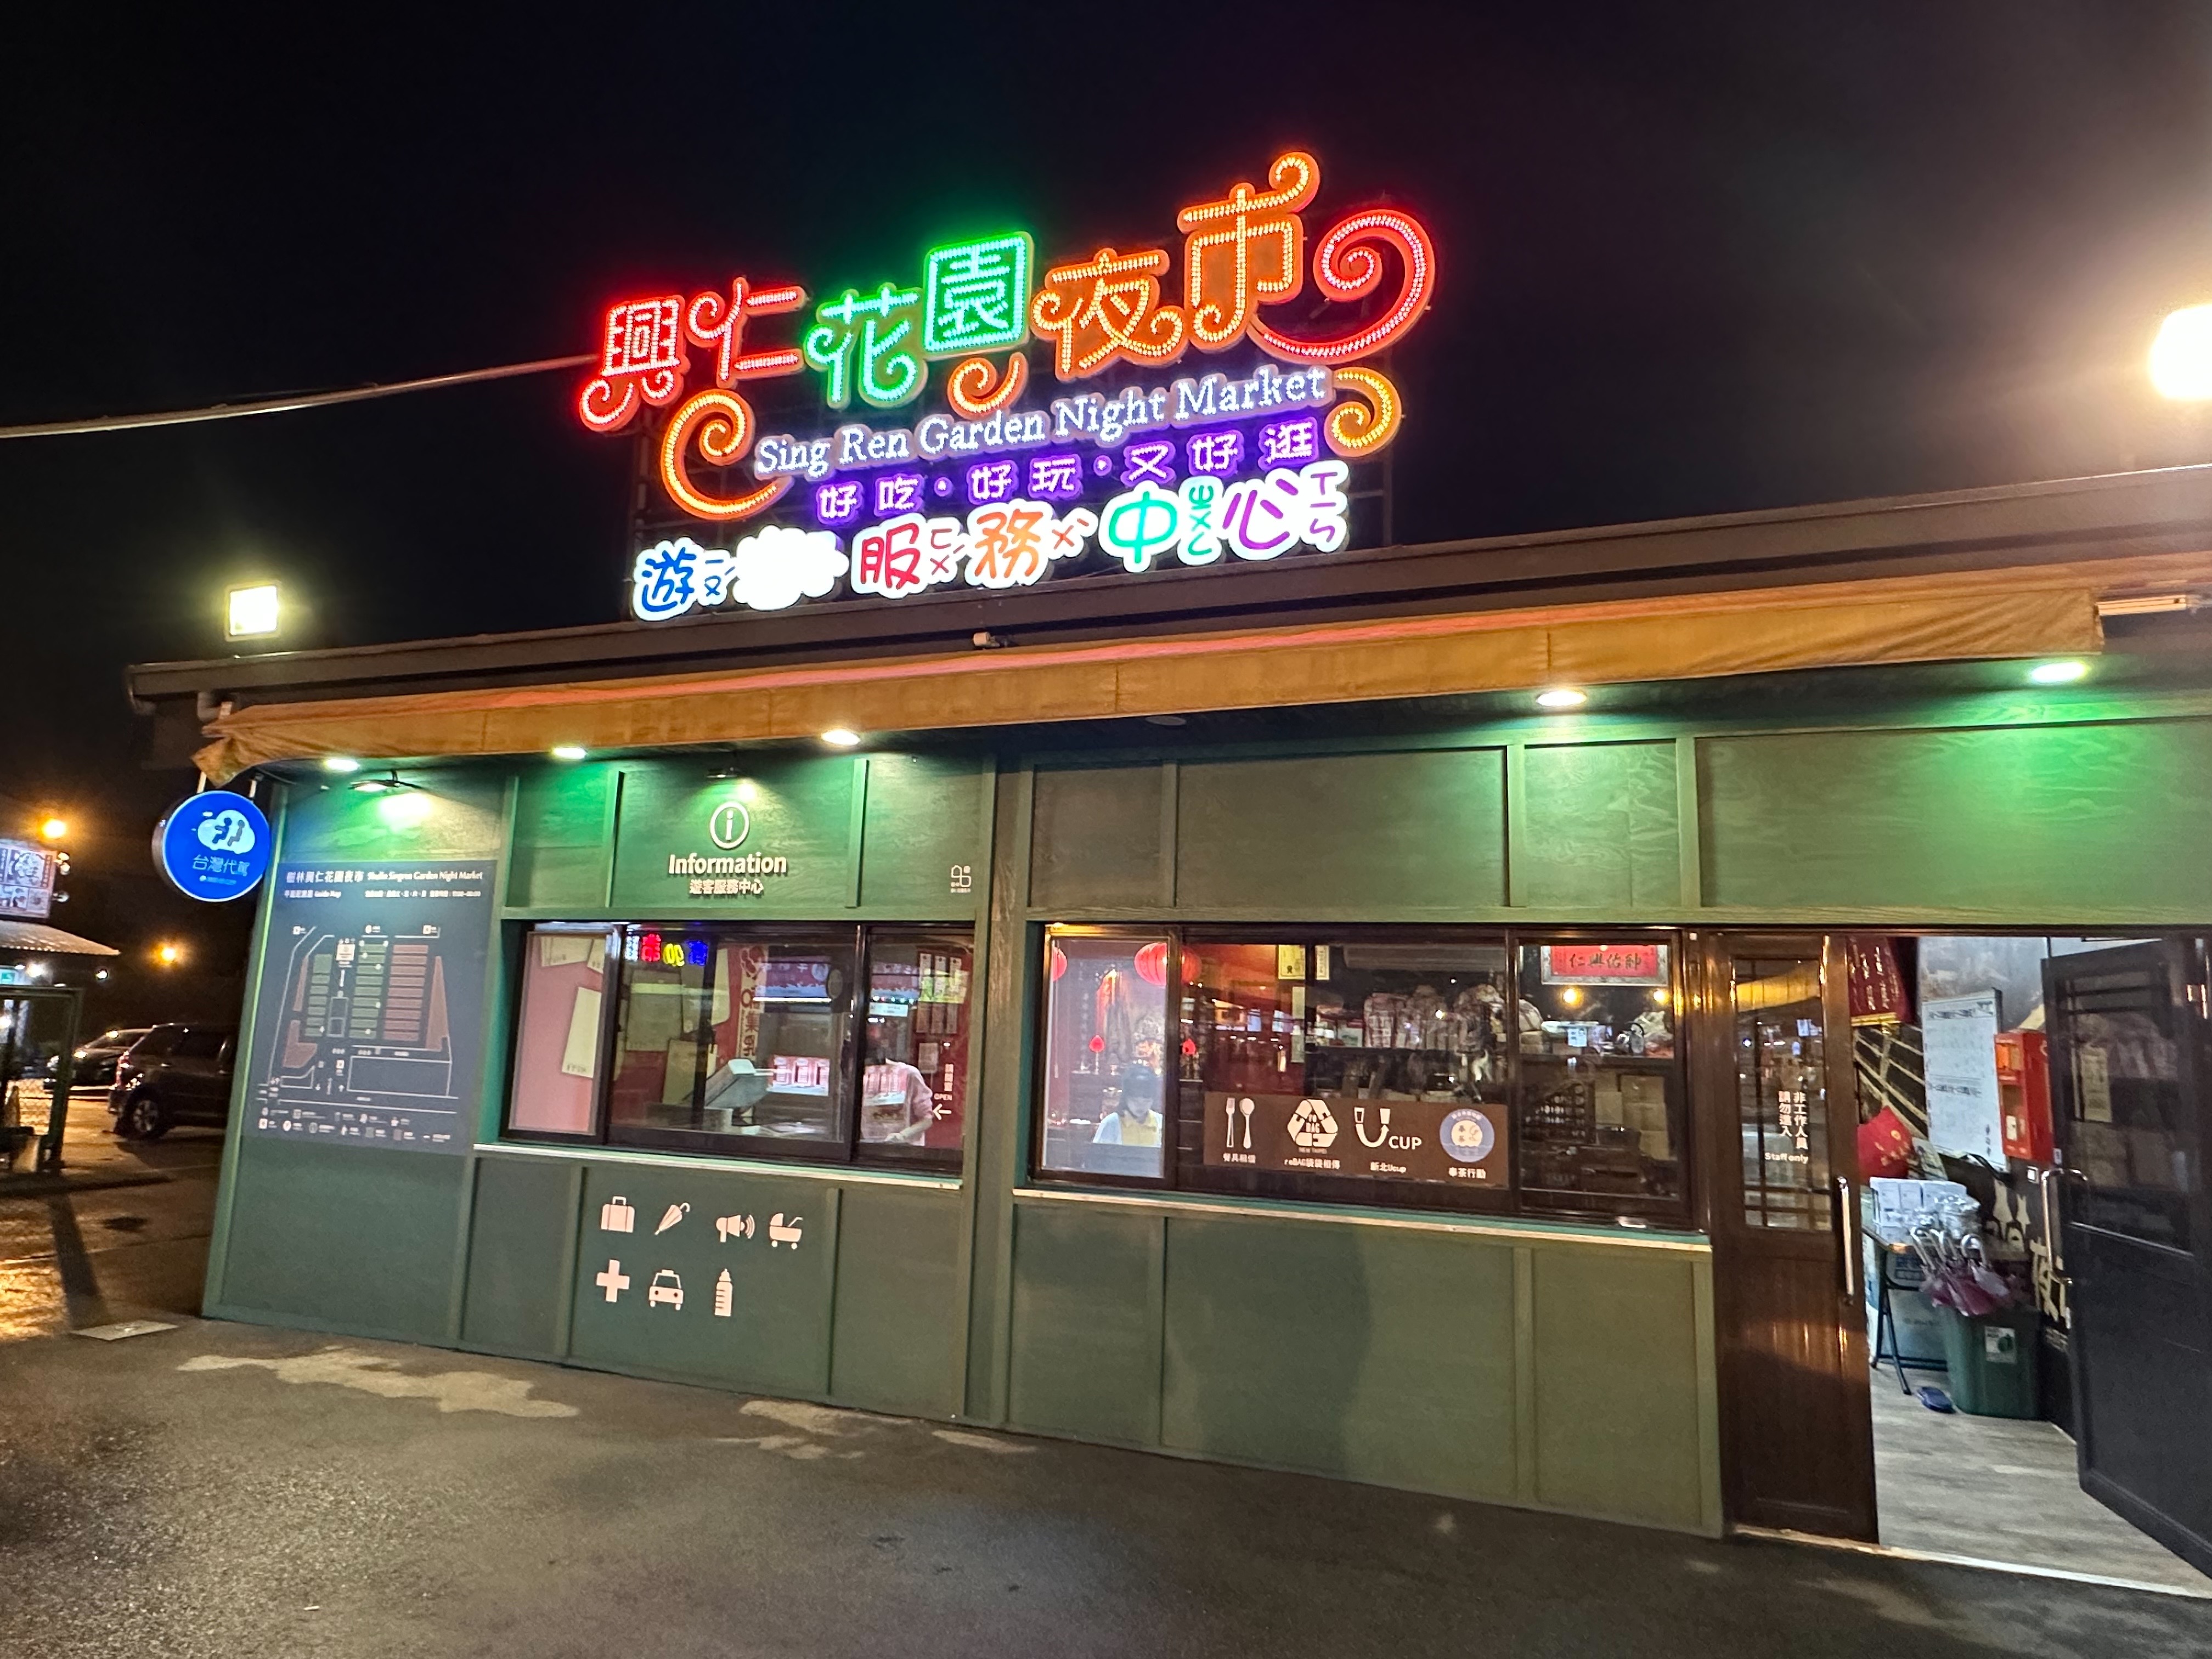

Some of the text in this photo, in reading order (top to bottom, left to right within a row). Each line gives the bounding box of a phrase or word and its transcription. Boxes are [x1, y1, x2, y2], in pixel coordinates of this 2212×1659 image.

[578, 152, 1319, 430] 興仁花園夜市
[757, 366, 1327, 477] Sing Ren Garden Night Market
[669, 851, 787, 874] Information
[689, 878, 764, 894] 遊客服務中心
[1388, 1136, 1422, 1150] CUP
[1764, 1152, 1808, 1164] Staff only
